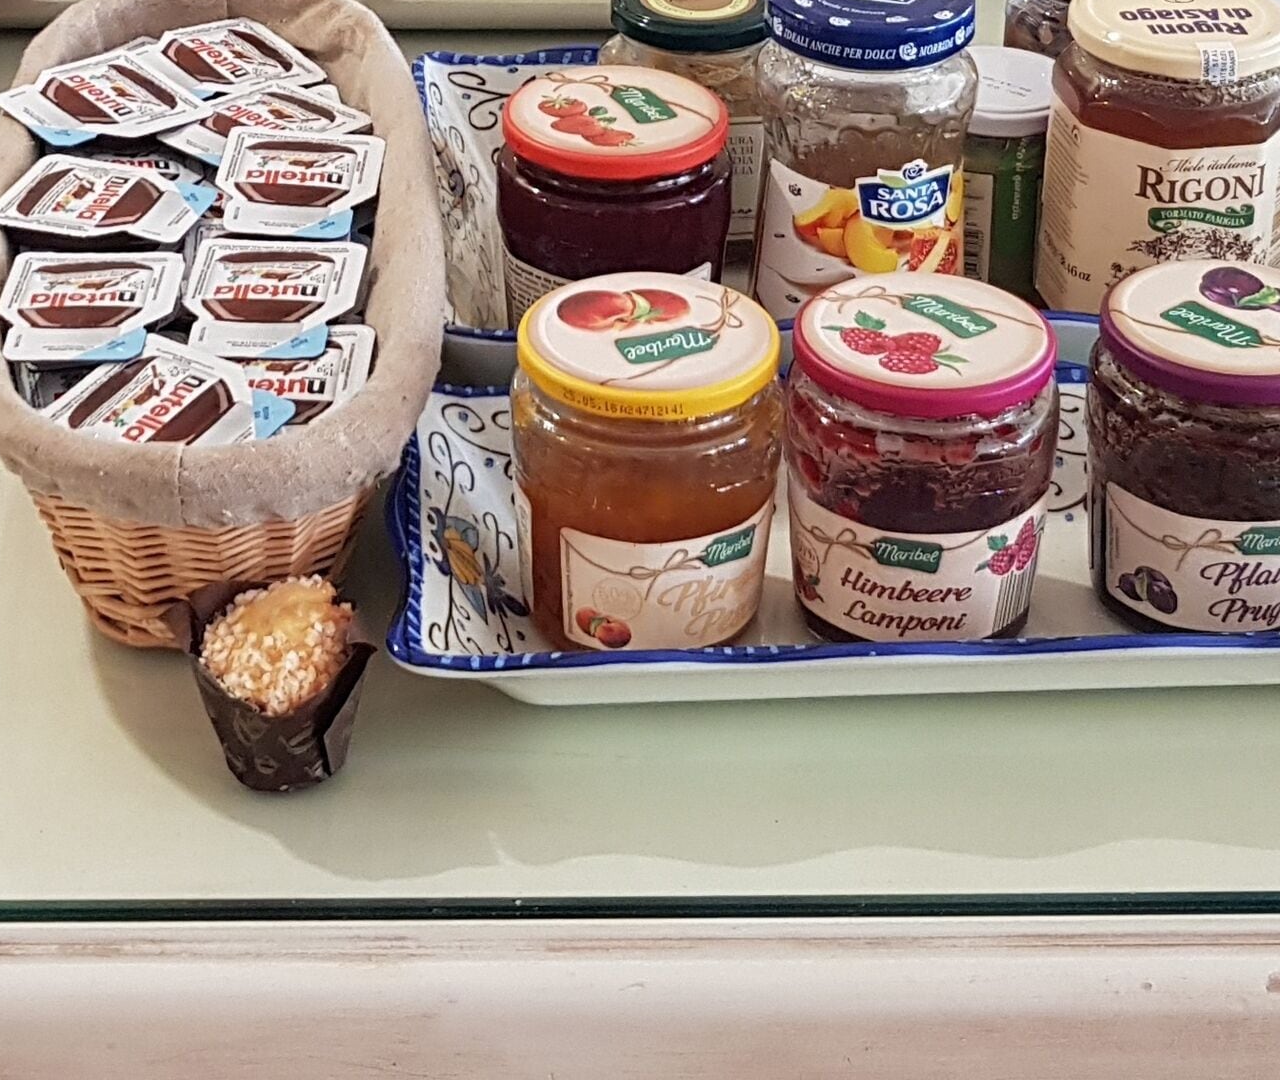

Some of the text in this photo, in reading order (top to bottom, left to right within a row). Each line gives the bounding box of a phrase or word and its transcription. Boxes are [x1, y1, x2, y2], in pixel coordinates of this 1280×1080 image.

[1120, 7, 1253, 21] di Asiago
[1147, 21, 1249, 35] Rigoni
[189, 37, 250, 79] nutella
[783, 28, 897, 60] IDEALI ANCHE PER DOLCI
[66, 74, 135, 117] nutella
[620, 87, 669, 120] Maribel
[226, 103, 291, 132] utella
[246, 169, 344, 185] nutella
[1166, 154, 1258, 173] Miele italiano
[76, 175, 131, 221] nutella
[877, 181, 939, 200] SANTA
[1134, 163, 1267, 204] RIGONI
[868, 190, 944, 219] ROSA
[1161, 209, 1246, 226] FORMATO FAMIGLIA
[30, 290, 137, 308] nutella
[213, 283, 320, 300] nutella
[910, 296, 987, 333] Maribel
[1168, 307, 1252, 345] Maribel
[624, 332, 712, 359] Maribel
[121, 374, 207, 444] nutella
[707, 533, 754, 561] Maribel
[875, 541, 940, 564] Maribel
[840, 566, 973, 604] Himbeere
[843, 599, 968, 638] Lamponi
